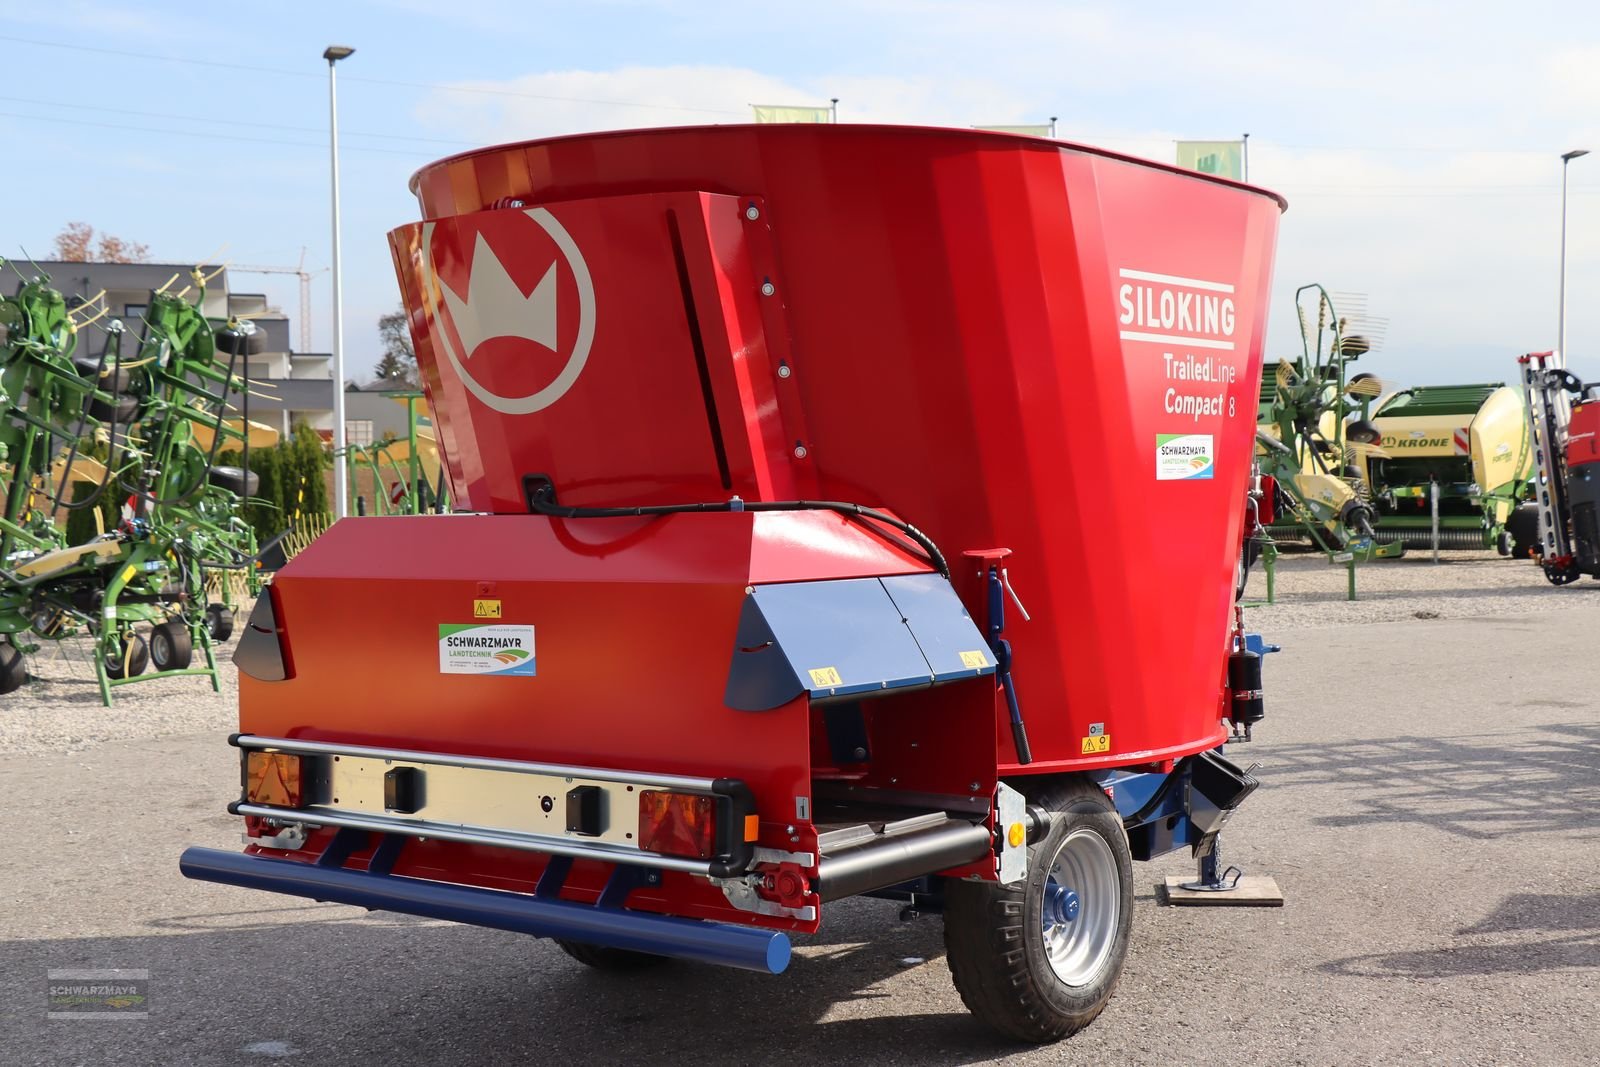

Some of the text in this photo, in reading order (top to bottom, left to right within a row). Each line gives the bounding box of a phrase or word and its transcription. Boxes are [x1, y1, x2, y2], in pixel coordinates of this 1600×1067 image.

[1119, 283, 1235, 336] SILOKING
[1163, 352, 1235, 383] TrailedLine
[1164, 387, 1236, 422] Compact 8
[1397, 438, 1450, 448] KRONE
[1161, 445, 1206, 456] SCHWARZMAYR
[447, 636, 522, 648] SCHWARZMAYR
[448, 650, 492, 658] LANDTECHNIK
